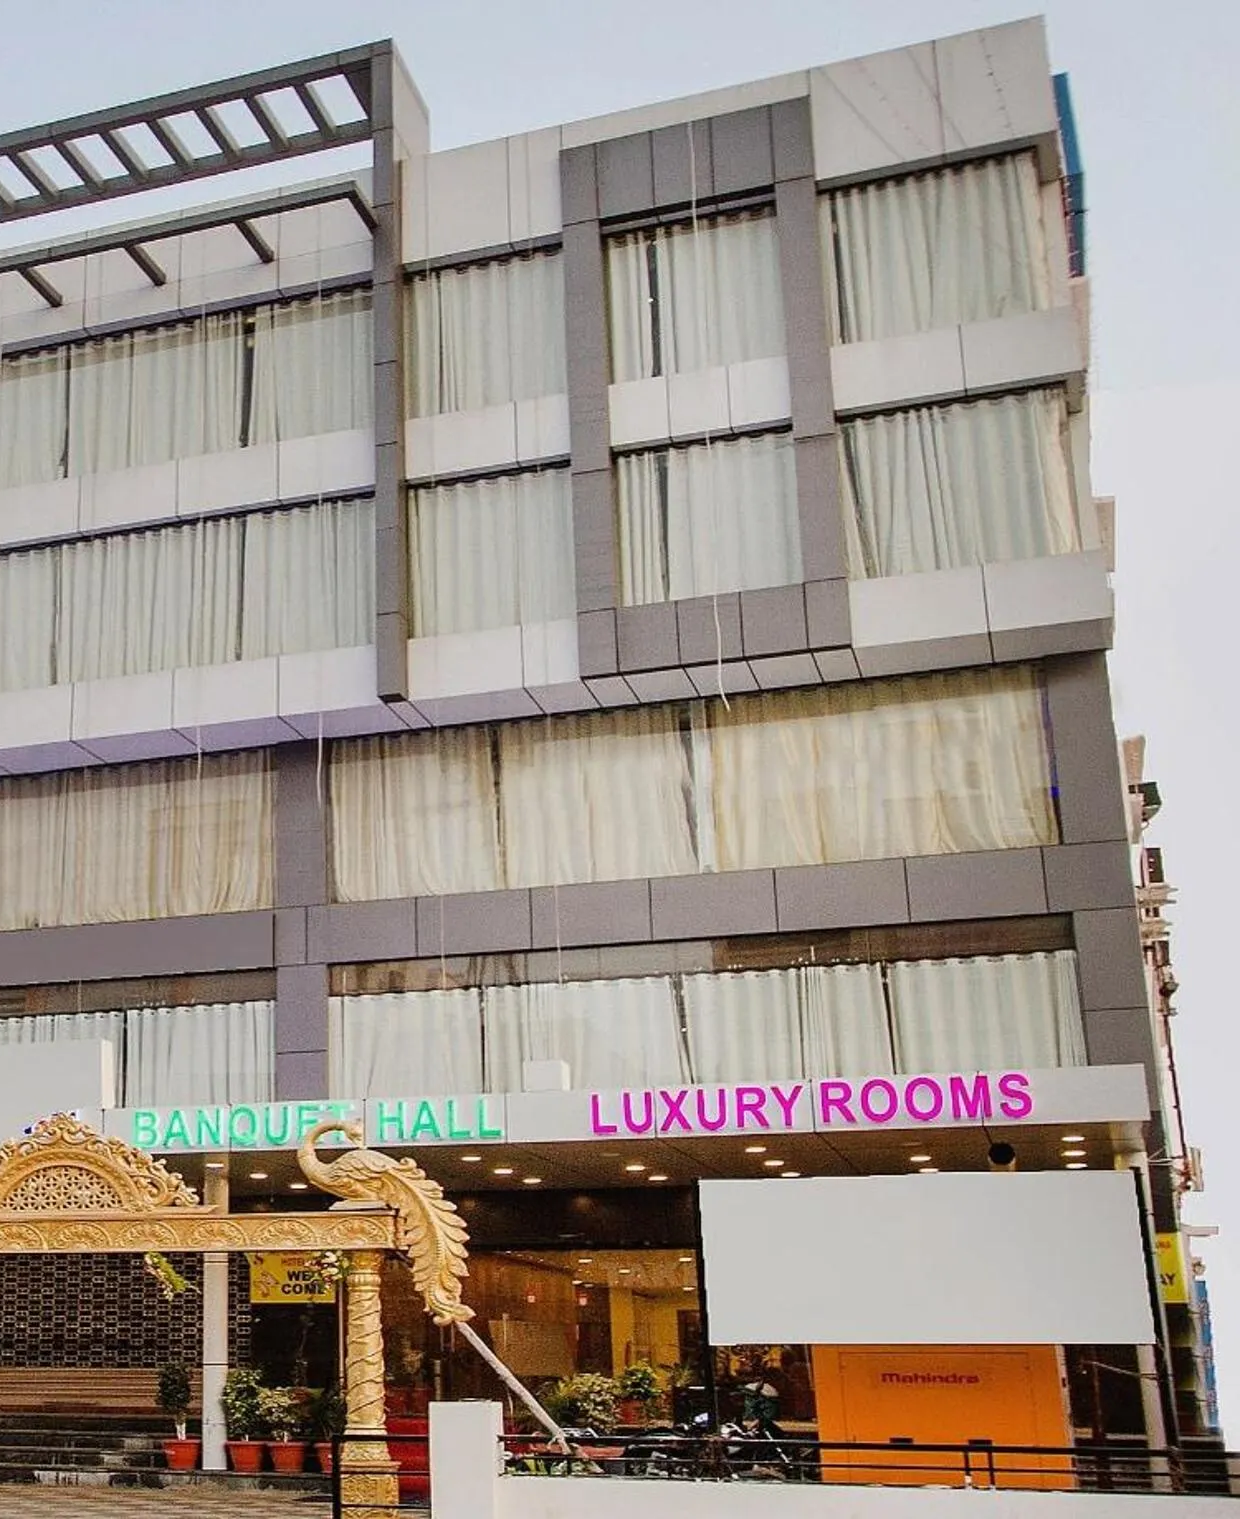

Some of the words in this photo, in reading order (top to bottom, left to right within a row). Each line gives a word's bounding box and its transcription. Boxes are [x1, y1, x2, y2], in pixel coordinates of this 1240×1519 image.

[133, 1104, 352, 1148] BANQUET
[377, 1099, 504, 1140] HALL
[590, 1084, 805, 1134] LUXURY
[819, 1073, 1034, 1124] ROOMS
